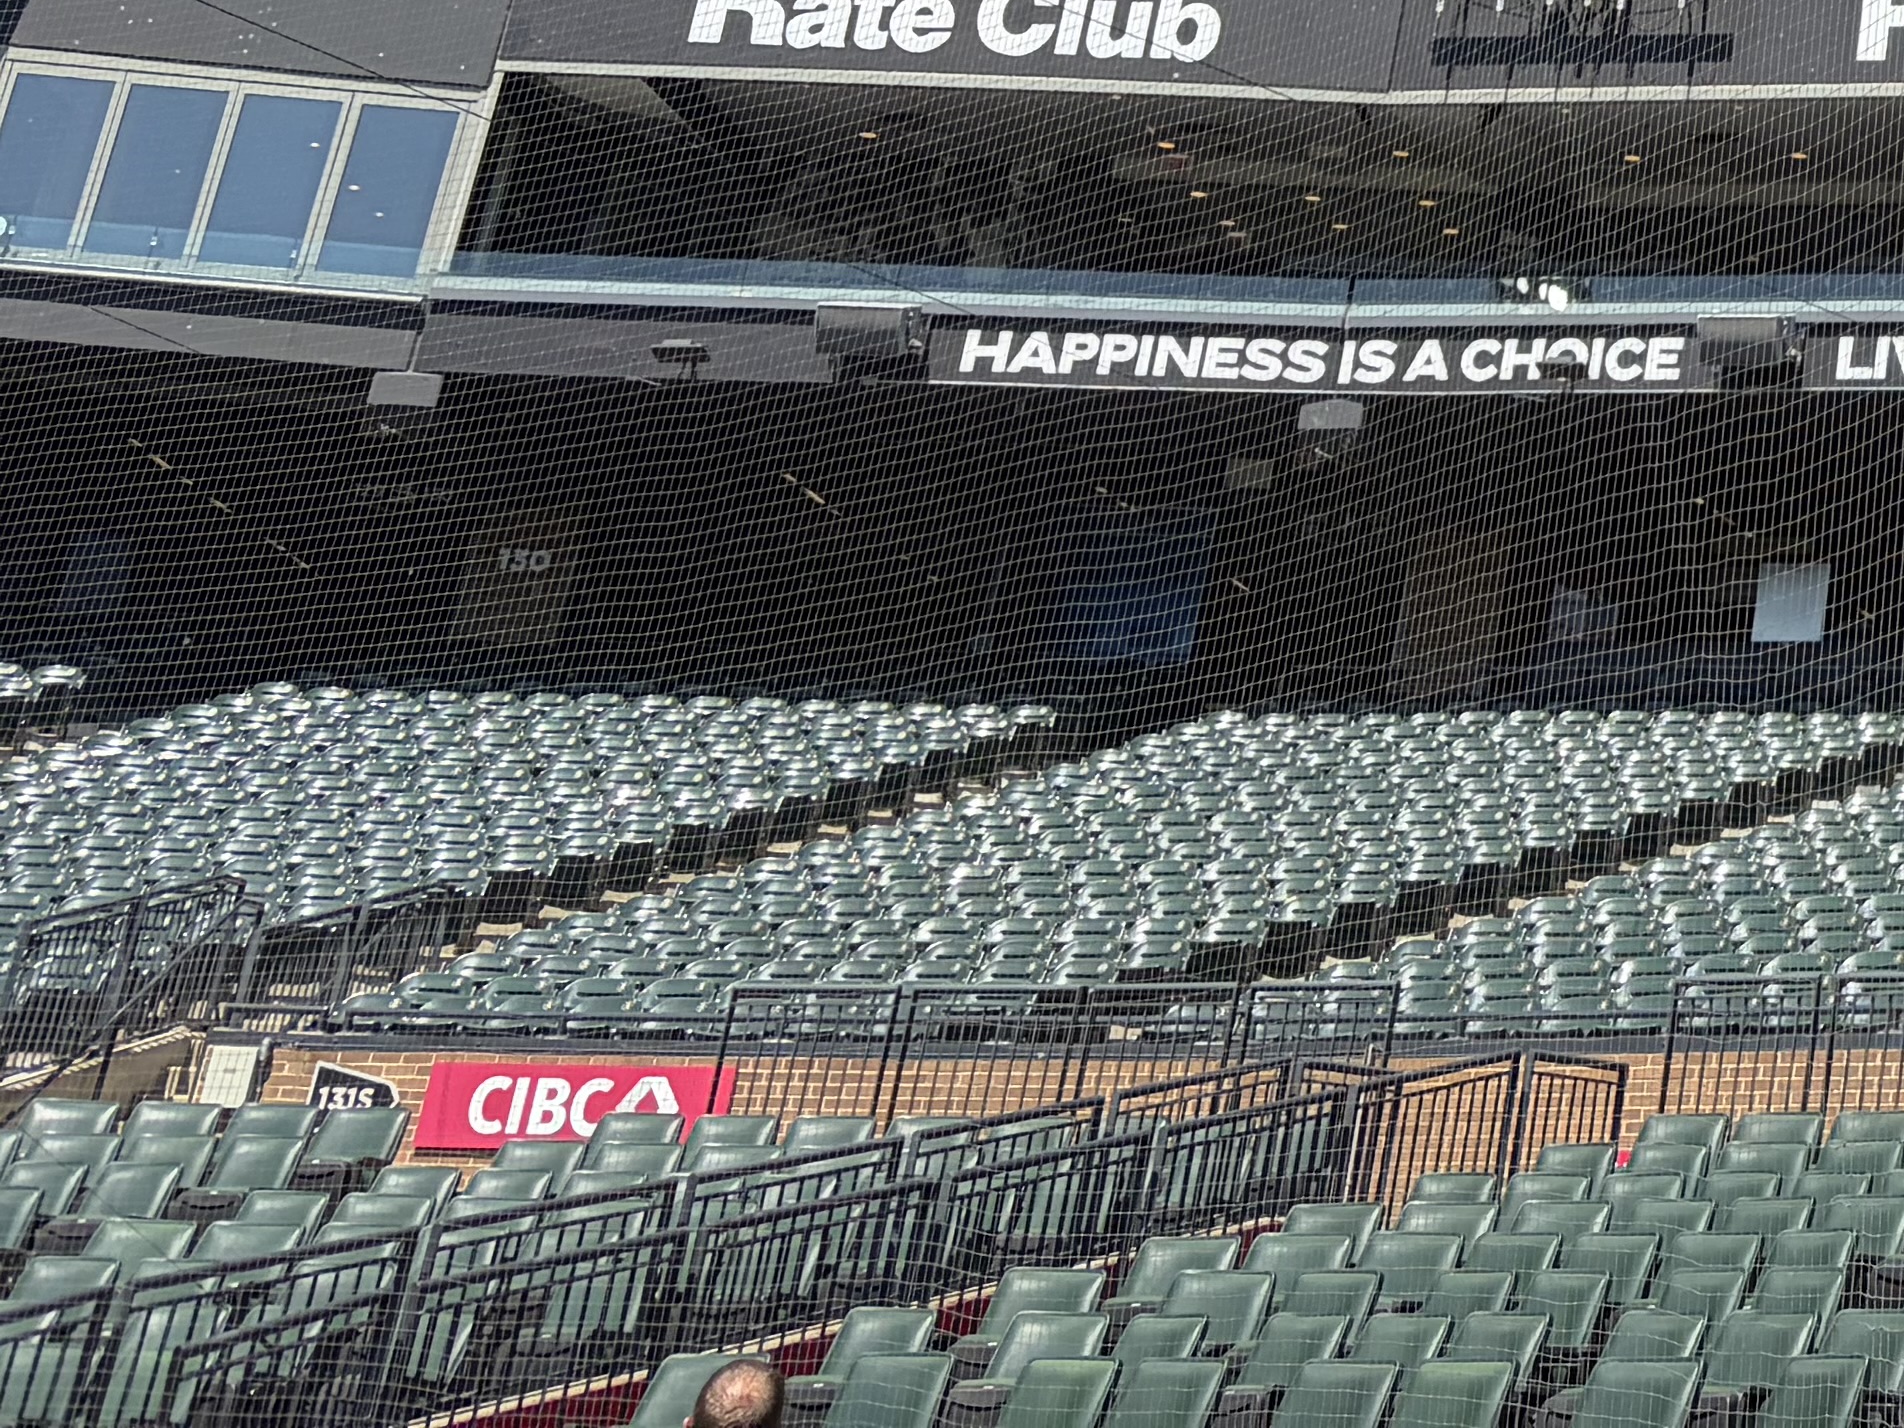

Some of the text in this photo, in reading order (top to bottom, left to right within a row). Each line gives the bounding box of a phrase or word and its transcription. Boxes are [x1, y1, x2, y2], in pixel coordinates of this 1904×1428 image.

[959, 328, 1327, 385] HAPPINESS
[1337, 337, 1396, 385] IS
[1402, 339, 1449, 382] A
[319, 1087, 374, 1110] 131S
[468, 1075, 615, 1138] CIBC
